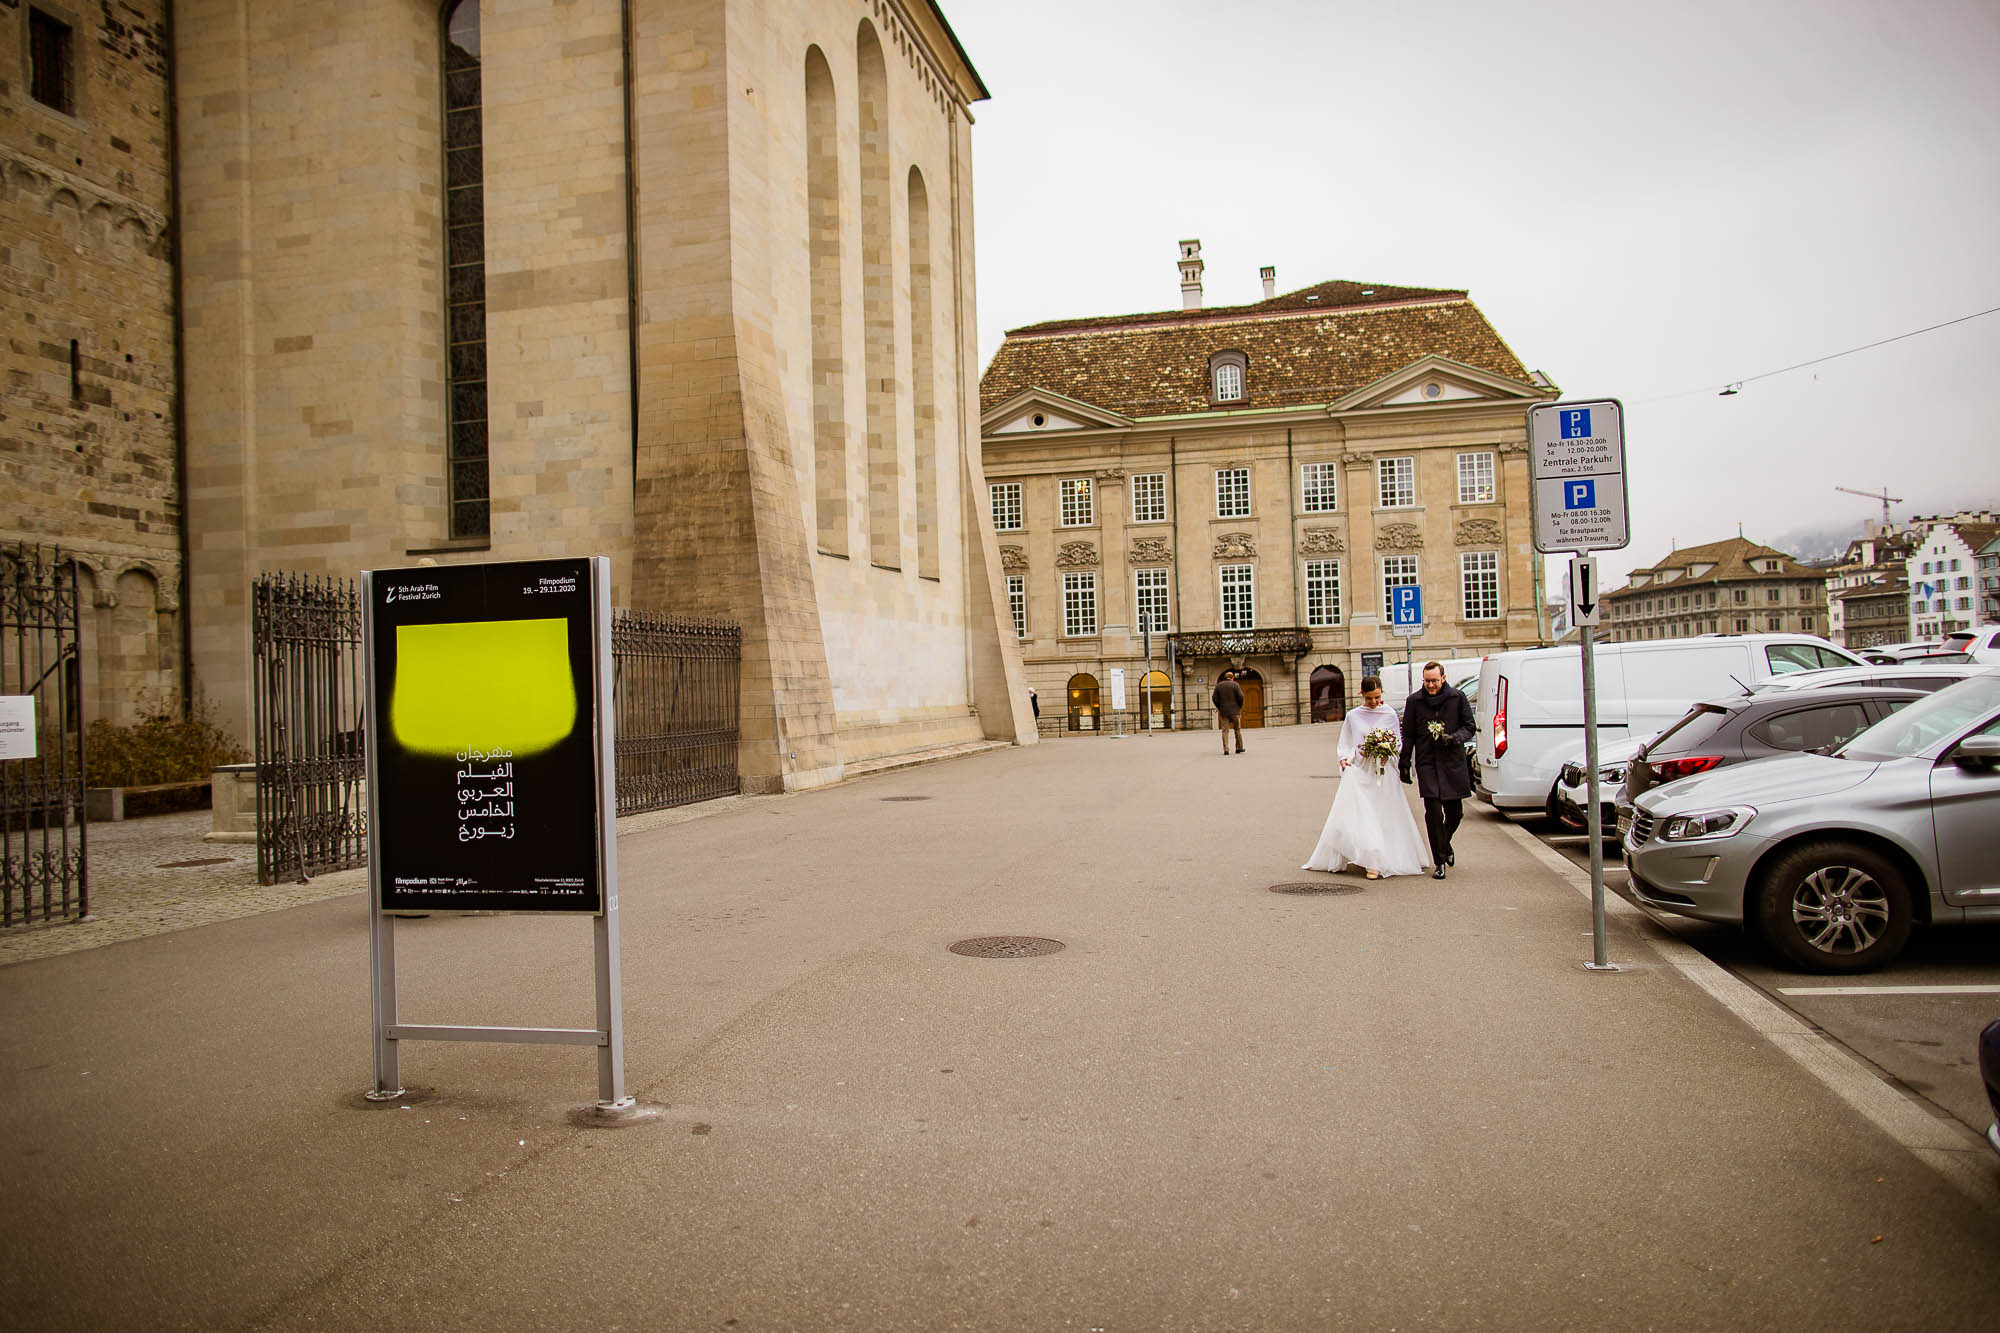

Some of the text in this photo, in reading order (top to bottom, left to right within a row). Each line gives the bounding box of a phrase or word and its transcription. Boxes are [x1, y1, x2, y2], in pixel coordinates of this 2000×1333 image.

[1570, 411, 1581, 427] P
[1567, 438, 1607, 447] 16.30-20.00h
[1568, 445, 1608, 454] 12.00-20.00h
[1543, 455, 1613, 467] Zentrale Parkuhr
[1573, 485, 1588, 506] P
[1570, 516, 1611, 525] 08.00-12.00h
[1570, 526, 1604, 534] Brautpaare
[1556, 534, 1609, 544] während Trauung
[539, 577, 576, 585] Filmpodium
[410, 584, 424, 592] Arab
[425, 583, 439, 591] Film
[539, 584, 576, 593] 29.11.2020
[421, 591, 441, 599] Zurich
[1401, 589, 1414, 608] P
[456, 743, 513, 762] مهرجان
[457, 762, 513, 785] الفيلم
[457, 781, 514, 805] العربي
[458, 801, 514, 820] الخامس
[458, 822, 515, 842] زيورخ
[395, 877, 428, 885] filmpodium
